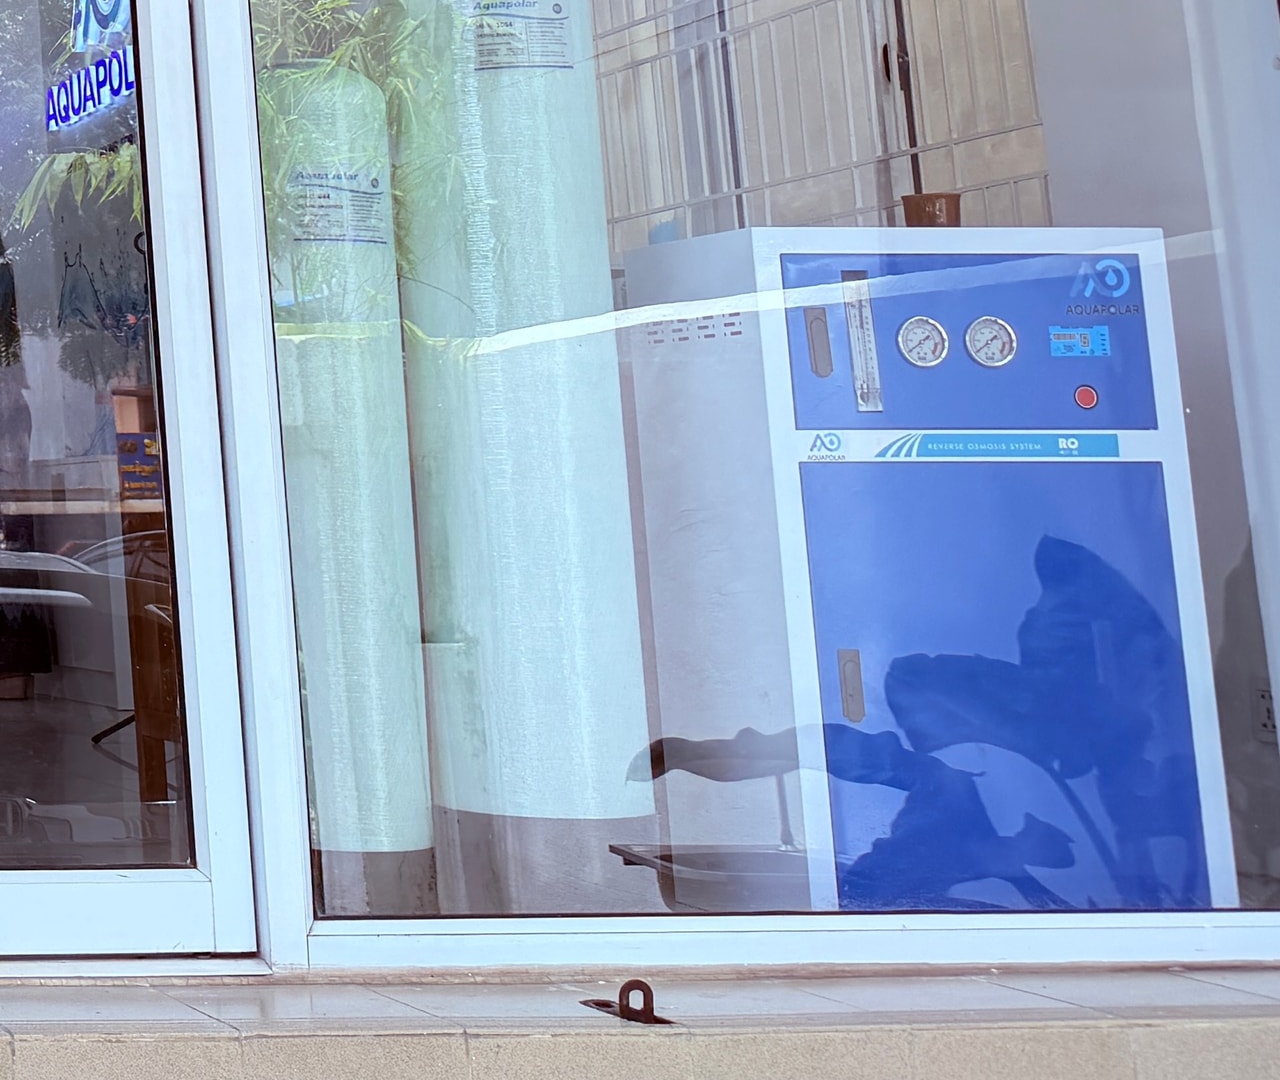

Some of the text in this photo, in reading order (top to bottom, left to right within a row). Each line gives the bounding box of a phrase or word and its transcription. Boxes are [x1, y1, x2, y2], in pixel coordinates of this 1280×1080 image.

[473, 0, 538, 11] Aquapolar
[1066, 304, 1139, 315] AQUAPOLAR
[1009, 442, 1042, 450] SYSTEM
[1057, 437, 1079, 449] RO
